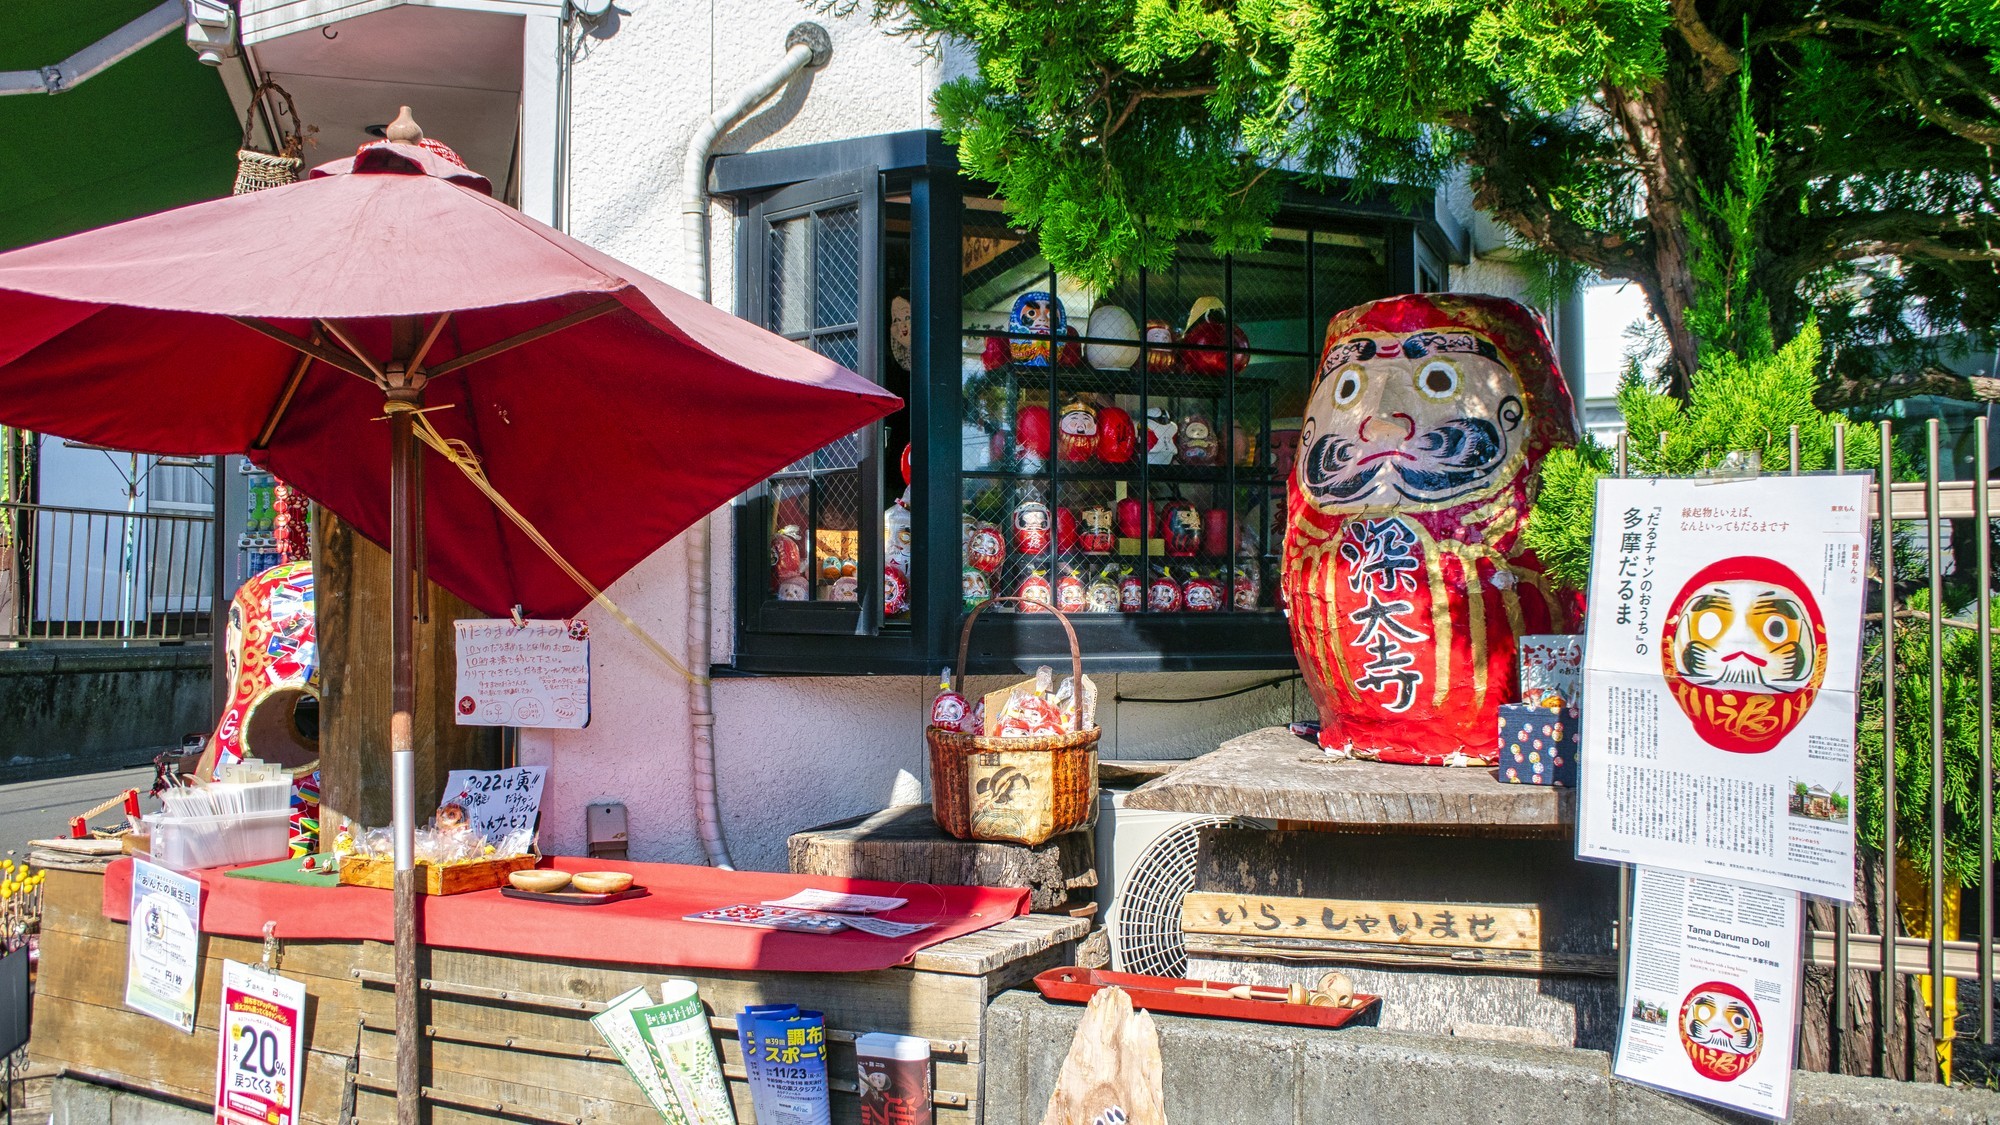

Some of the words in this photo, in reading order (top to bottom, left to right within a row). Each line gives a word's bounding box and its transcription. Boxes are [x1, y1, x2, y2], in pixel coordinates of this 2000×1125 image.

[1681, 507, 1753, 519] 縁起物といえば、
[1680, 521, 1789, 533] なんといってもだるまです
[1616, 507, 1645, 625] 多摩だるま
[1340, 517, 1429, 712] 深大寺
[226, 767, 232, 777] 5
[1216, 899, 1498, 942] いらっしゃいませ
[1687, 924, 1712, 937] Tama
[1714, 930, 1750, 945] Daruma
[1752, 937, 1771, 949] Doll
[1725, 942, 1741, 950] House
[765, 1046, 828, 1064] スポーツ
[773, 1067, 807, 1080] 11/23
[234, 1073, 272, 1095] 戻ってくる
